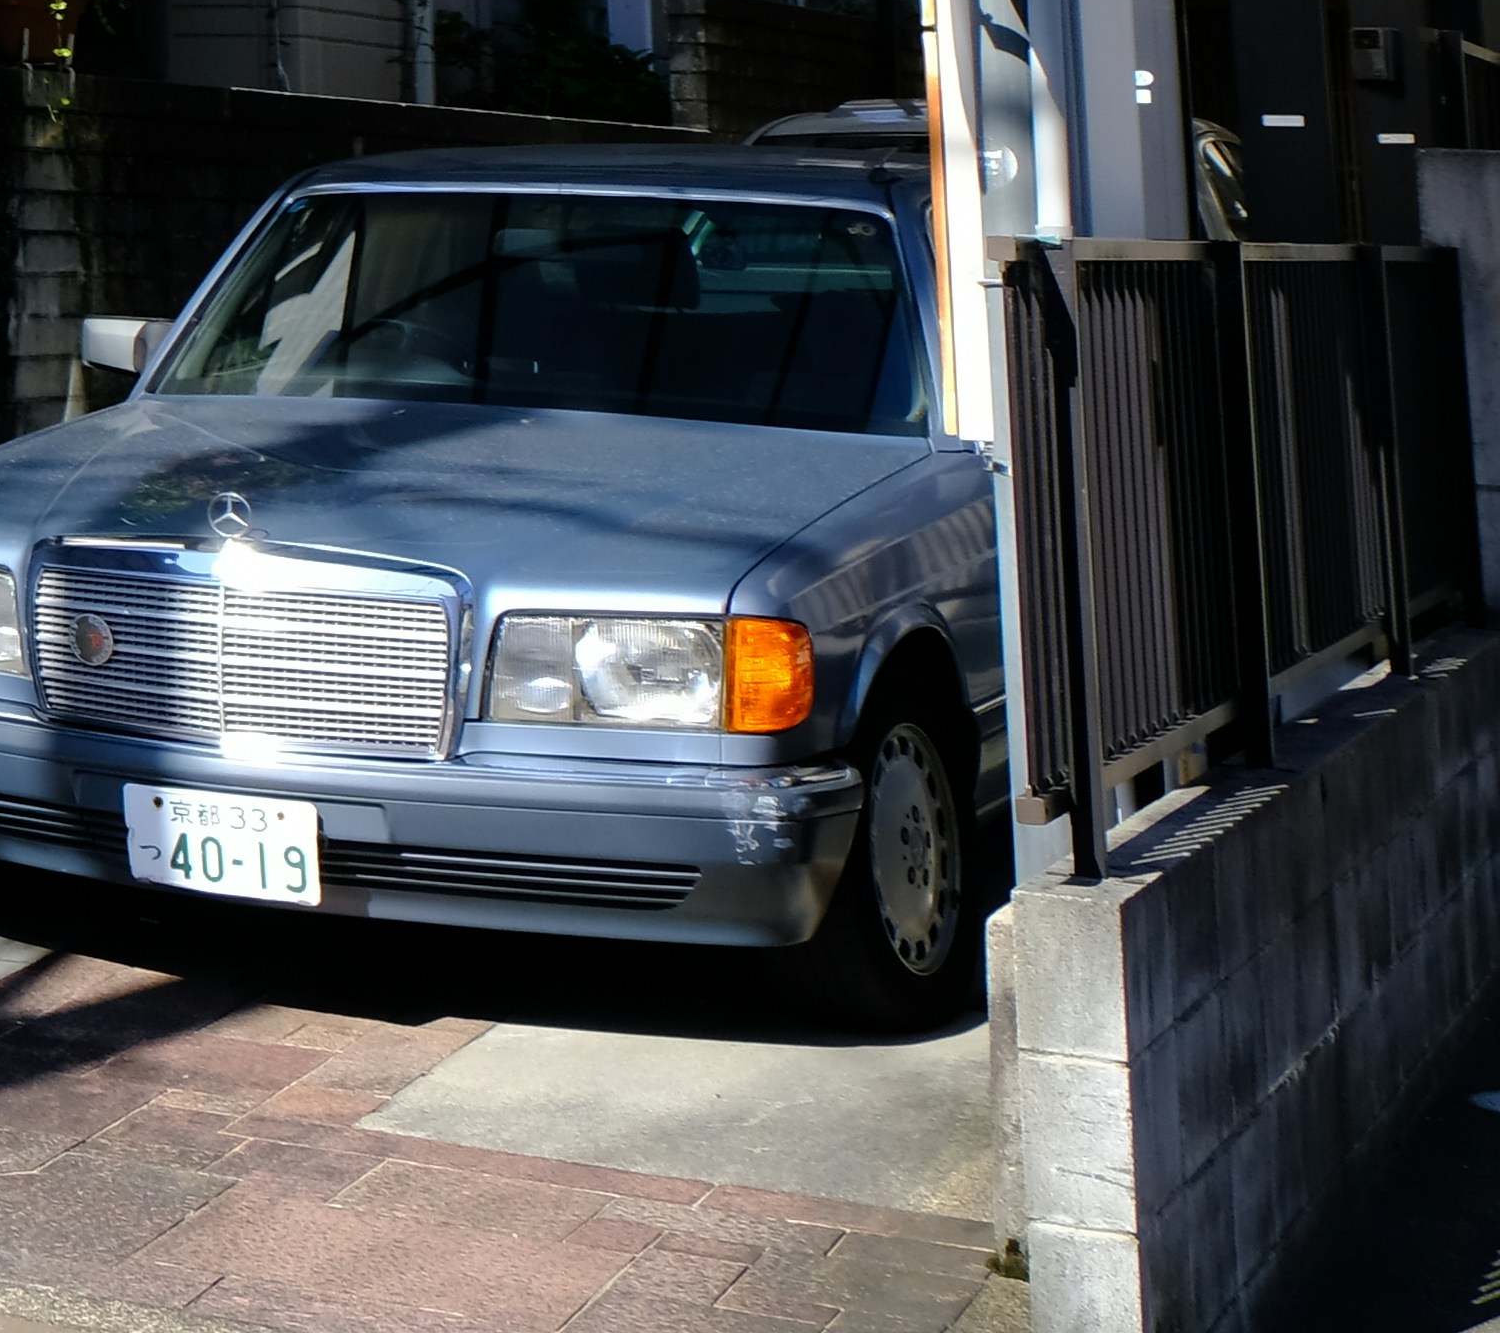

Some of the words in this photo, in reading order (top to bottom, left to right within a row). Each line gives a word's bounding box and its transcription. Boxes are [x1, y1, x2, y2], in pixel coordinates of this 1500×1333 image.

[168, 799, 221, 827] 京都
[229, 806, 268, 833] 33
[139, 844, 162, 861] つ
[169, 832, 308, 894] 40-19
